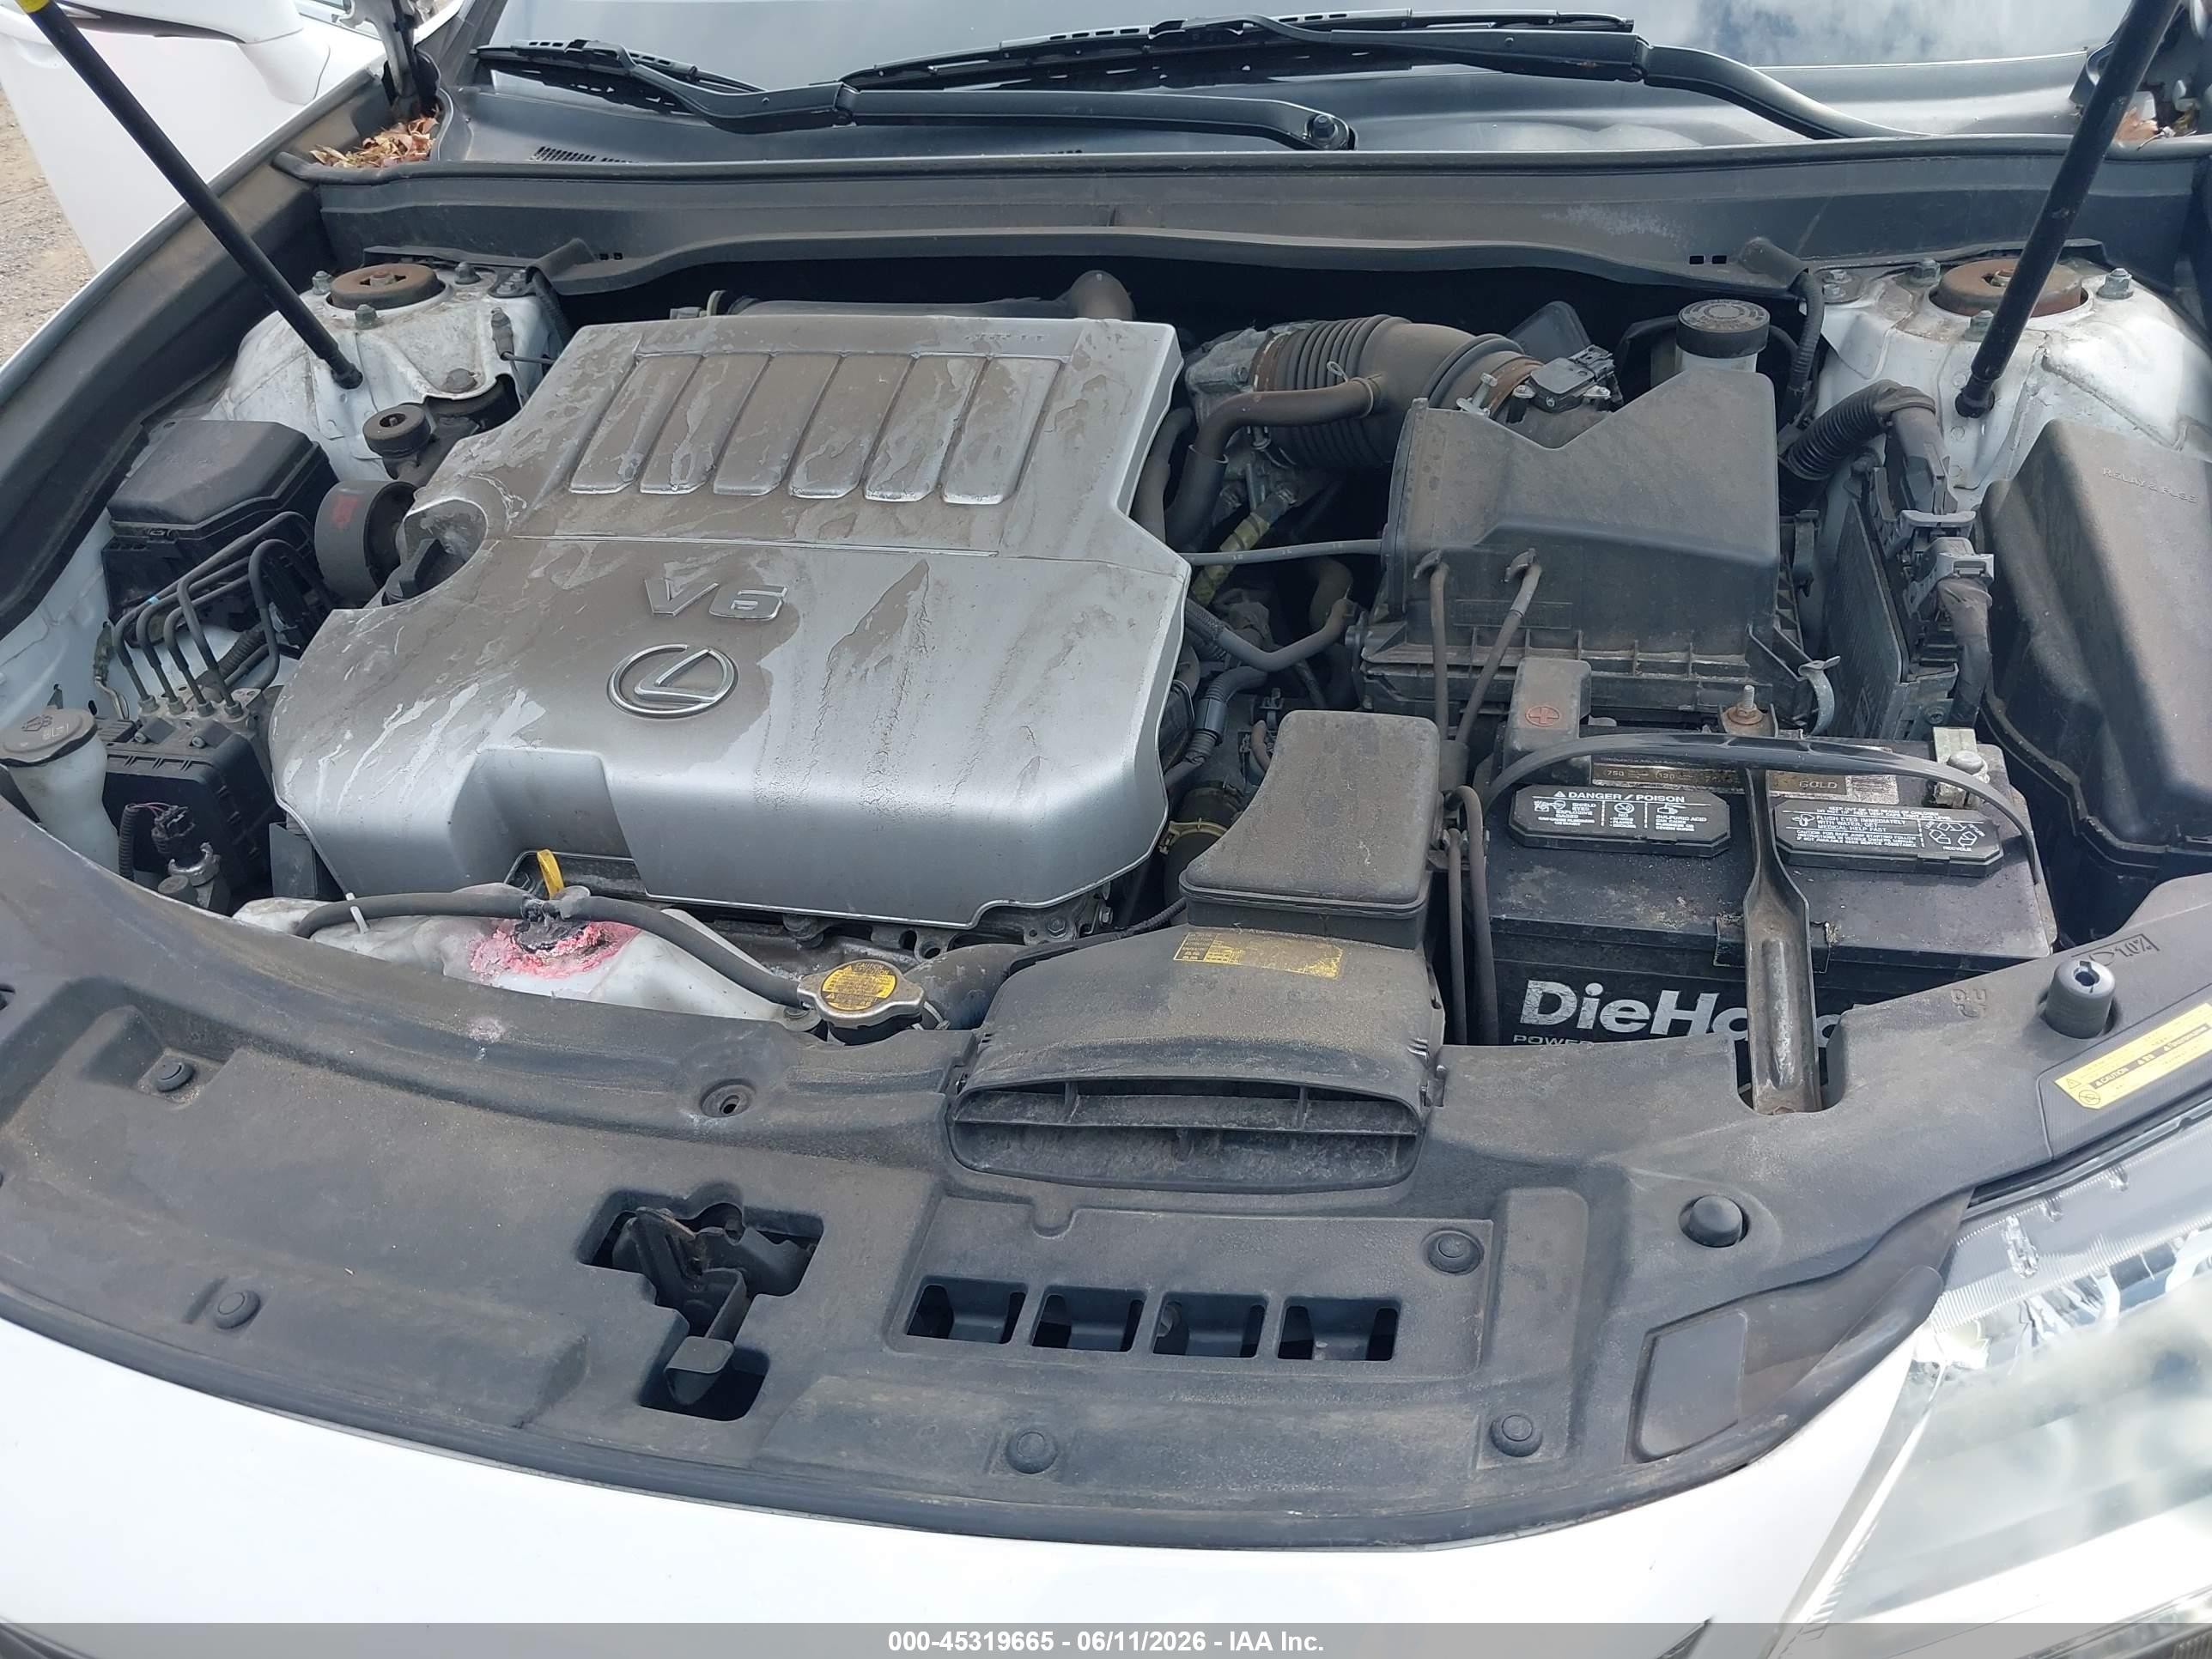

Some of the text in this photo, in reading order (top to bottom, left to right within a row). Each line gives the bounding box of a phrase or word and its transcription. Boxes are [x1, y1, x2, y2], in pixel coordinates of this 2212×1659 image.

[2102, 466, 2145, 487] RELAY
[644, 576, 788, 622] V6
[1799, 780, 1838, 789] GOLD
[1568, 791, 1622, 799] DANGER
[1636, 793, 1686, 803] POISON
